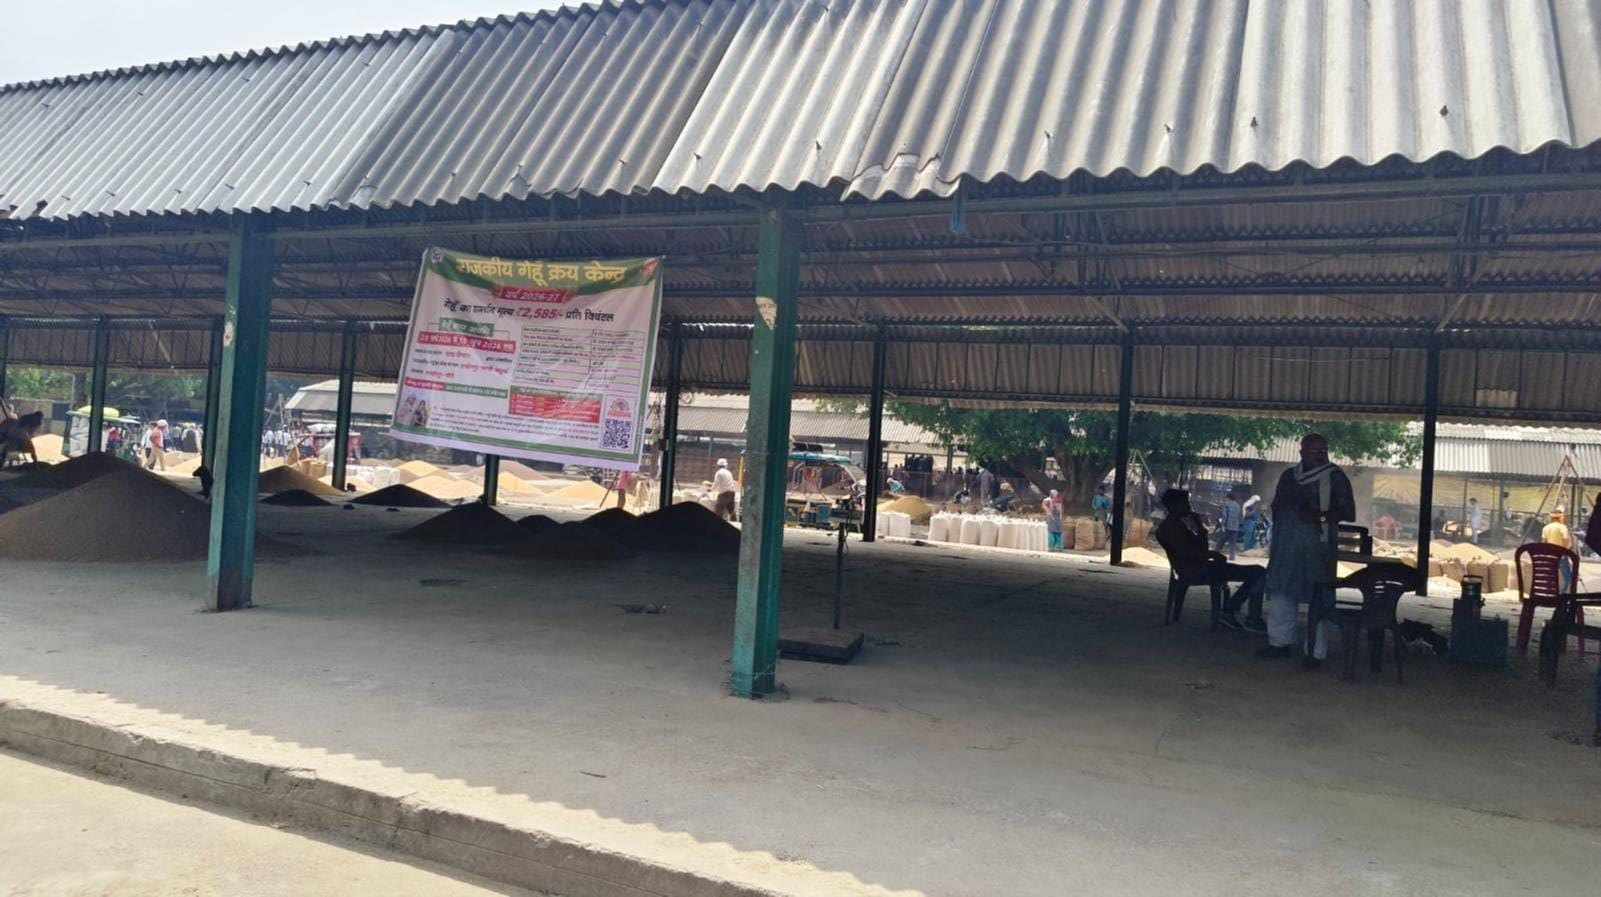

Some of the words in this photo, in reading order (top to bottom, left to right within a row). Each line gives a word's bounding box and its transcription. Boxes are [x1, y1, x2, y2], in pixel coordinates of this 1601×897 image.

[457, 257, 513, 277] राजकीय
[547, 265, 579, 282] क्रय
[566, 308, 582, 321] प्रति
